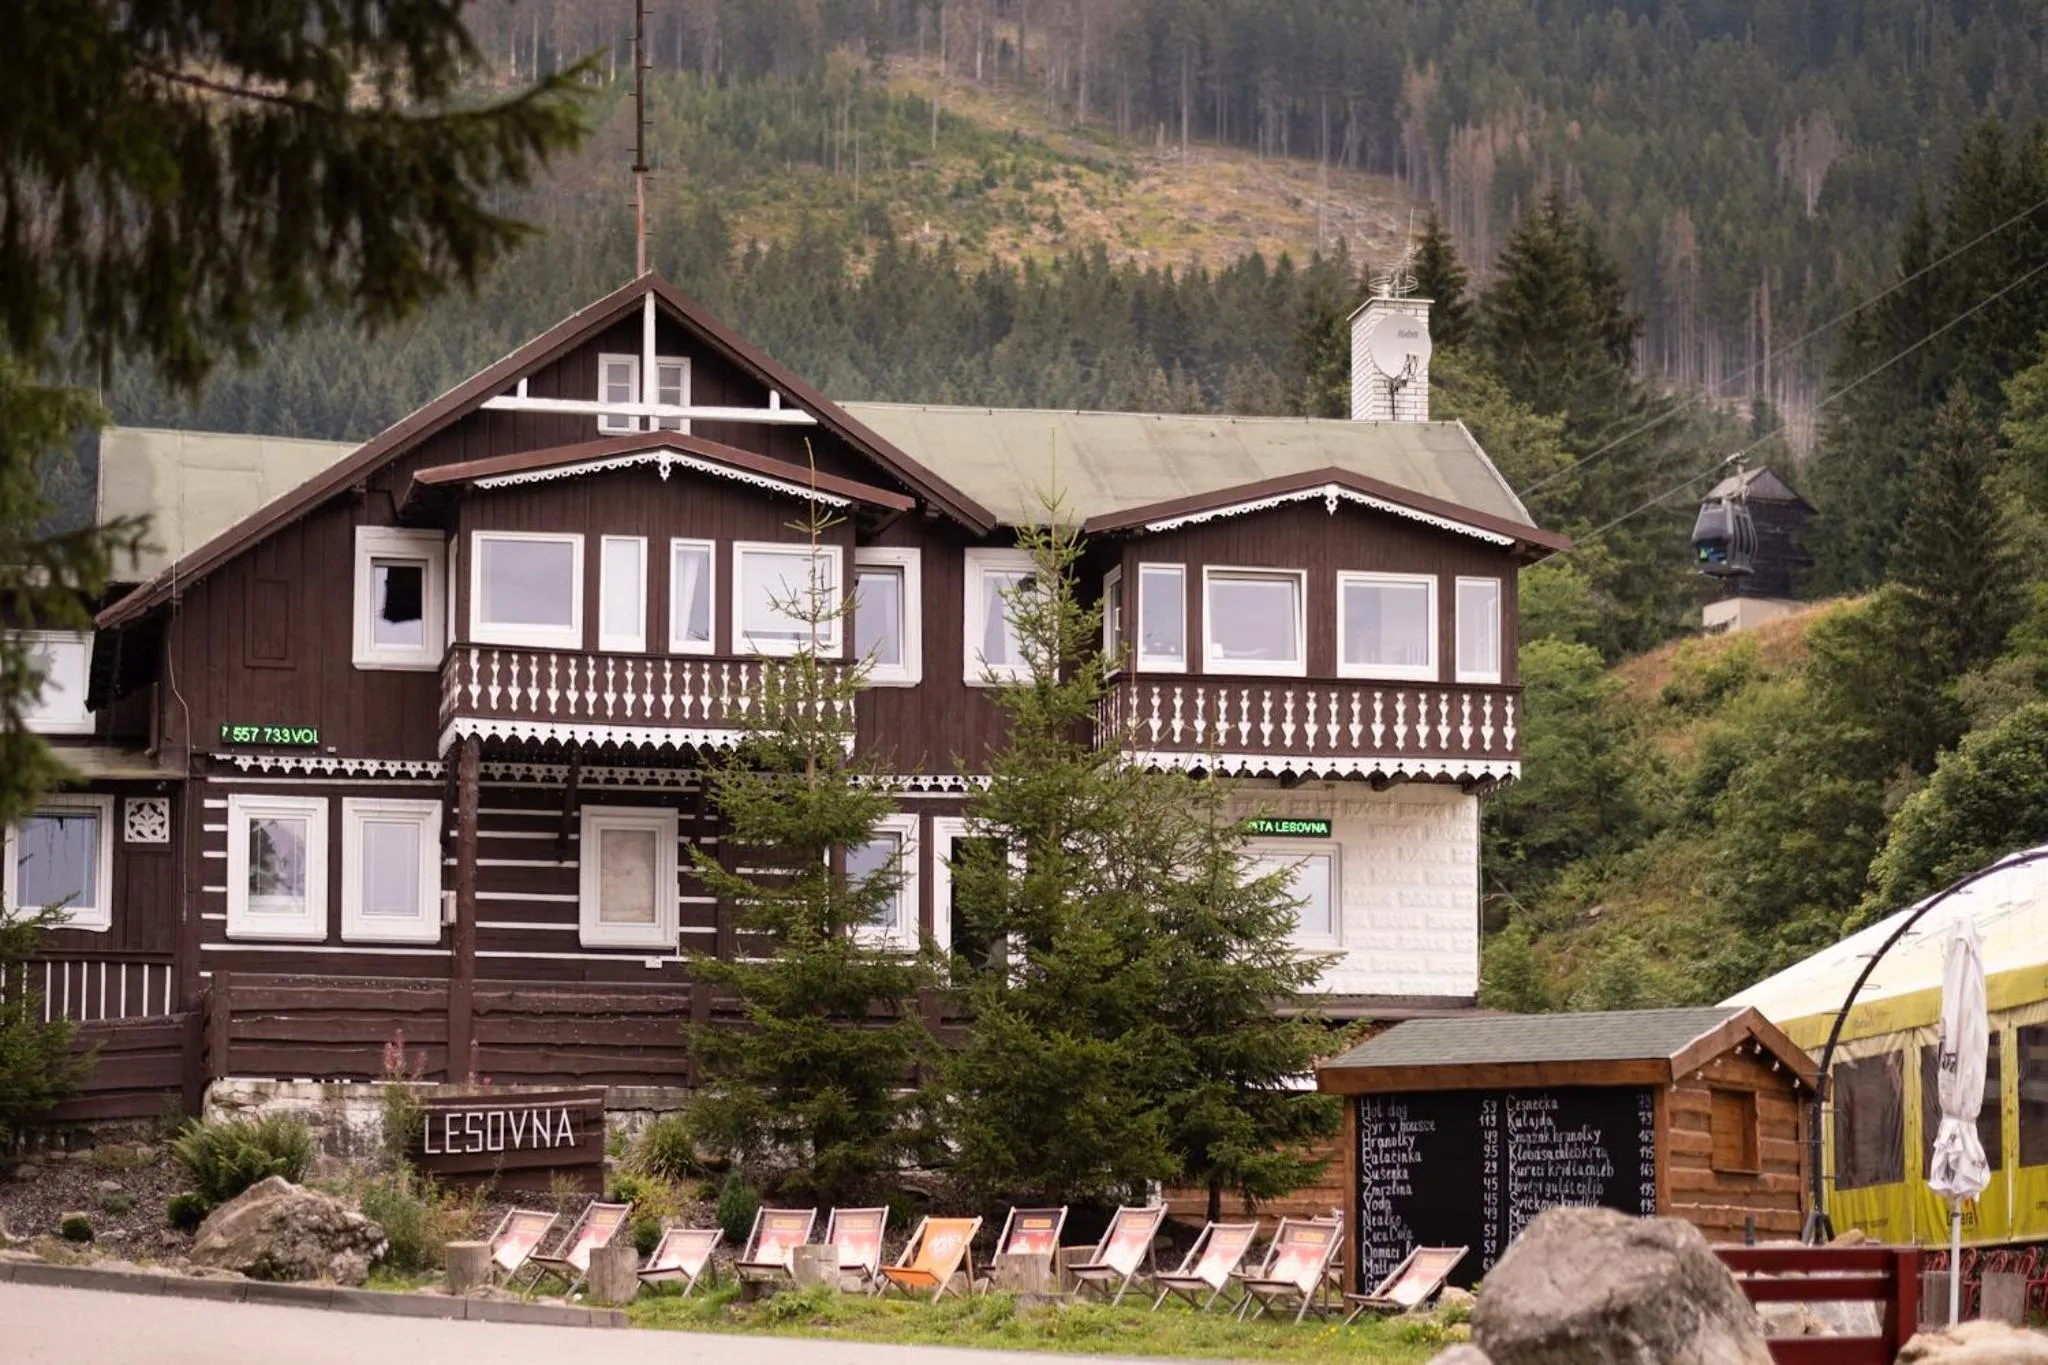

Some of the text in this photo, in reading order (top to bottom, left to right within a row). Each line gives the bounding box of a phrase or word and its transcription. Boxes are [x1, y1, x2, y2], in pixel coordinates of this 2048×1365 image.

[232, 726, 259, 742] 557
[1275, 821, 1328, 834] LESOVNA
[1360, 1097, 1497, 1122] Hot dog 59
[424, 1107, 576, 1154] LESOVNA
[1390, 1122, 1397, 1132] v
[1399, 1117, 1437, 1133] housce
[1479, 1114, 1497, 1128] 119
[1507, 1110, 1554, 1132] Kulajda
[1362, 1129, 1498, 1152] Hranolky 49
[1483, 1144, 1499, 1158] 95
[1483, 1161, 1498, 1174] 29
[1362, 1177, 1499, 1196] Zmrzlina 45
[1362, 1192, 1498, 1212] Voda 45
[1362, 1206, 1498, 1228] Nealko 49
[1483, 1223, 1498, 1237] 59
[1483, 1239, 1497, 1254] 59
